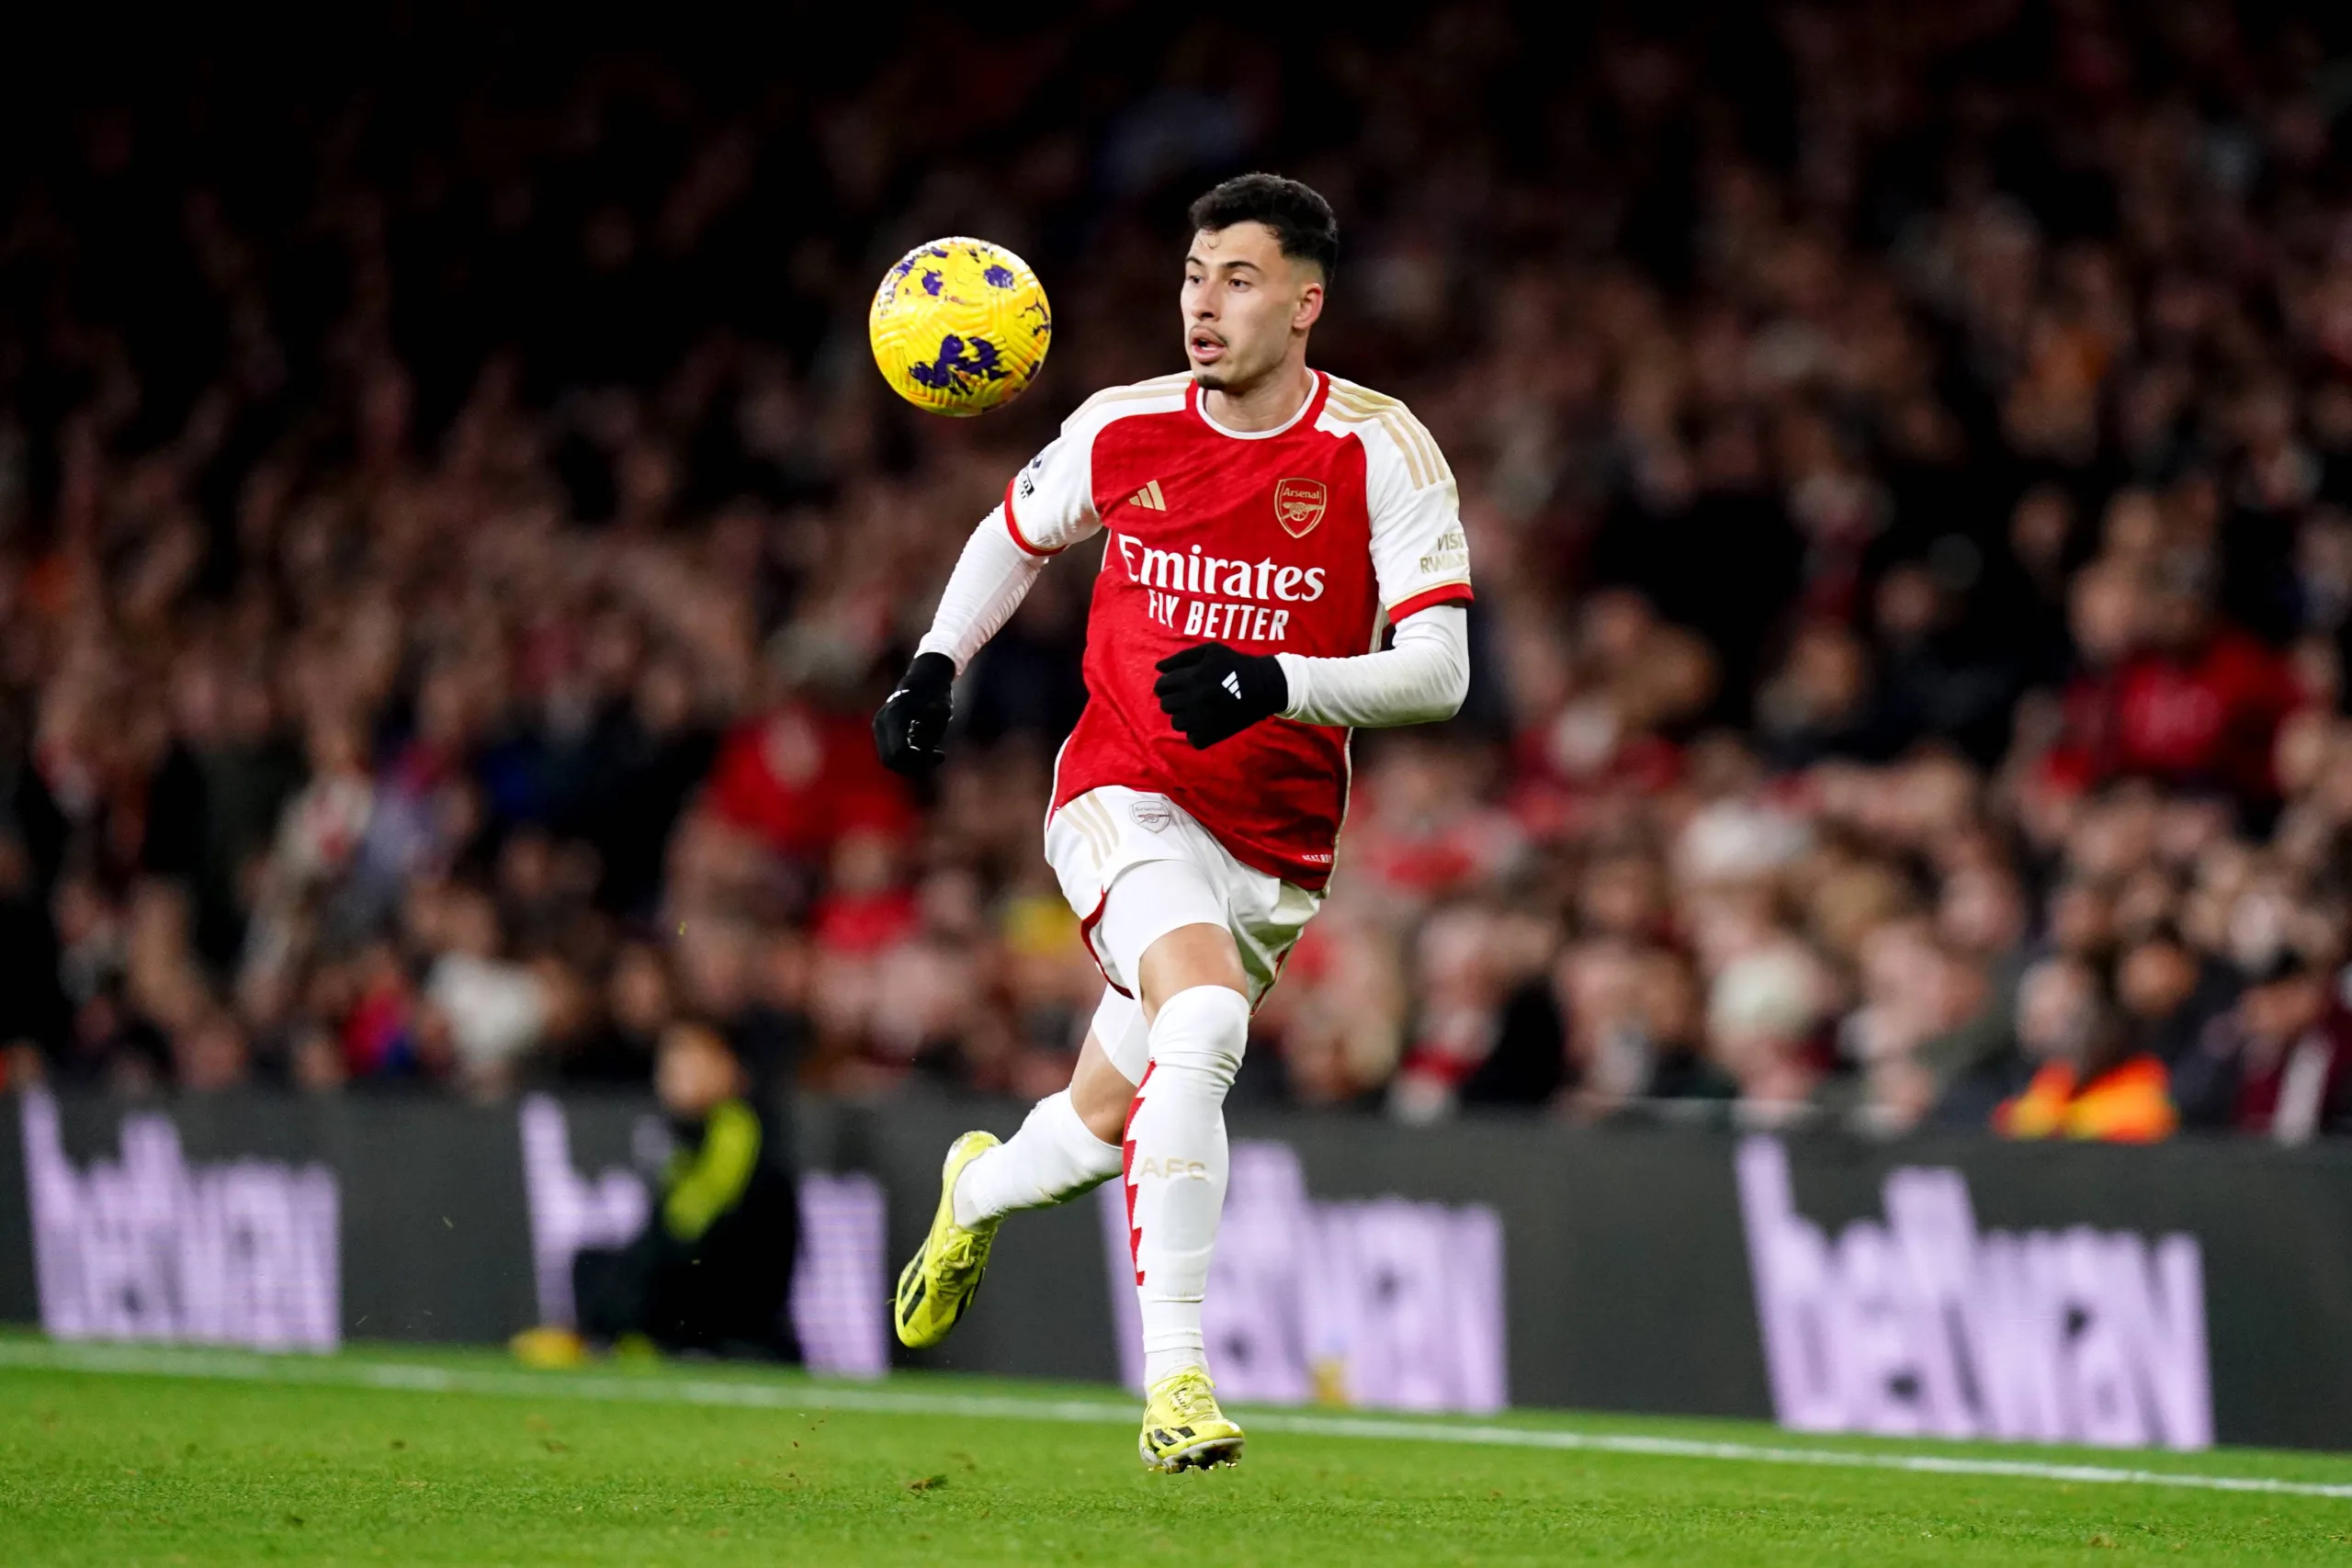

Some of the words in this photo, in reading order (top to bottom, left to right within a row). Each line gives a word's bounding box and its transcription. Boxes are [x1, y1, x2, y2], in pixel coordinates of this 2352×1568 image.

[1283, 487, 1320, 500] Arsenal
[1437, 532, 1465, 552] VISI
[1117, 533, 1326, 602] Emirates
[1148, 588, 1181, 629] FLY
[1183, 600, 1290, 641] BETTER
[1140, 1156, 1207, 1180] AFC
